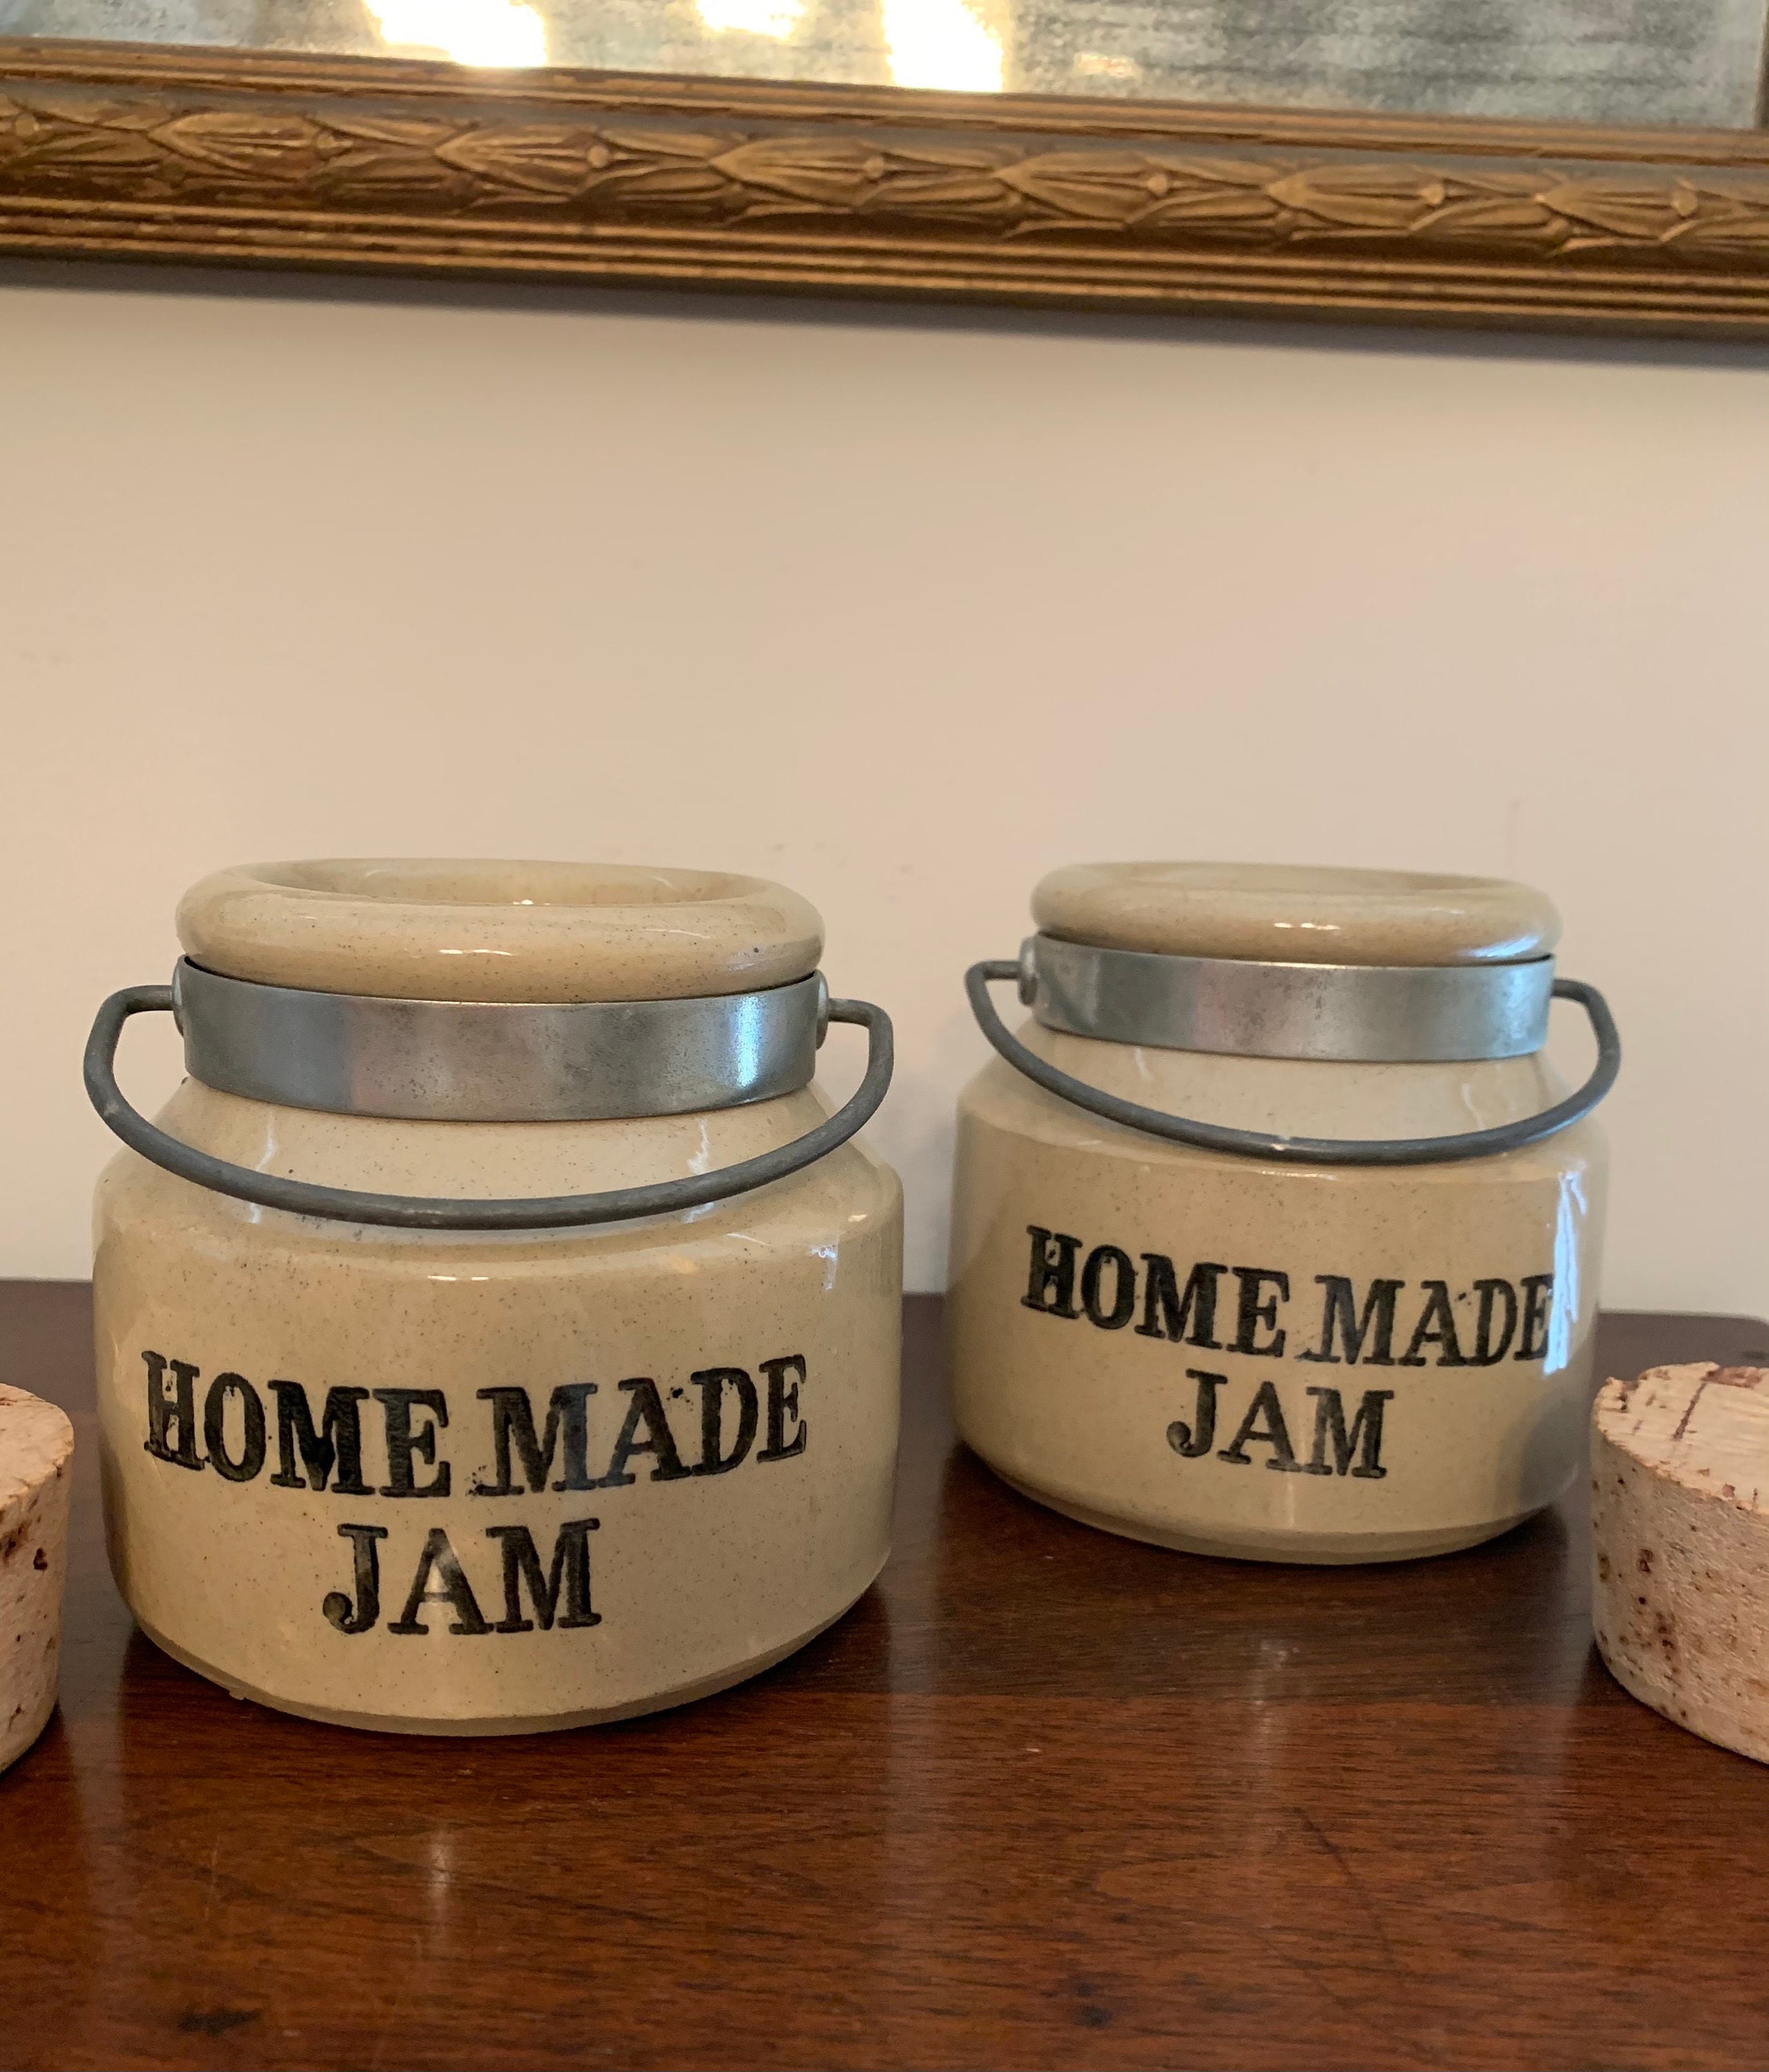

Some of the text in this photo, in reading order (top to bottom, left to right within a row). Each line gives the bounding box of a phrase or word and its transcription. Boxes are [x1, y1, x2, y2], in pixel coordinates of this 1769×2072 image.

[1019, 1224, 1555, 1368] HOME MADE
[140, 1349, 809, 1499] HOME MADE
[1165, 1368, 1395, 1479] JAM
[321, 1517, 603, 1637] JAM
